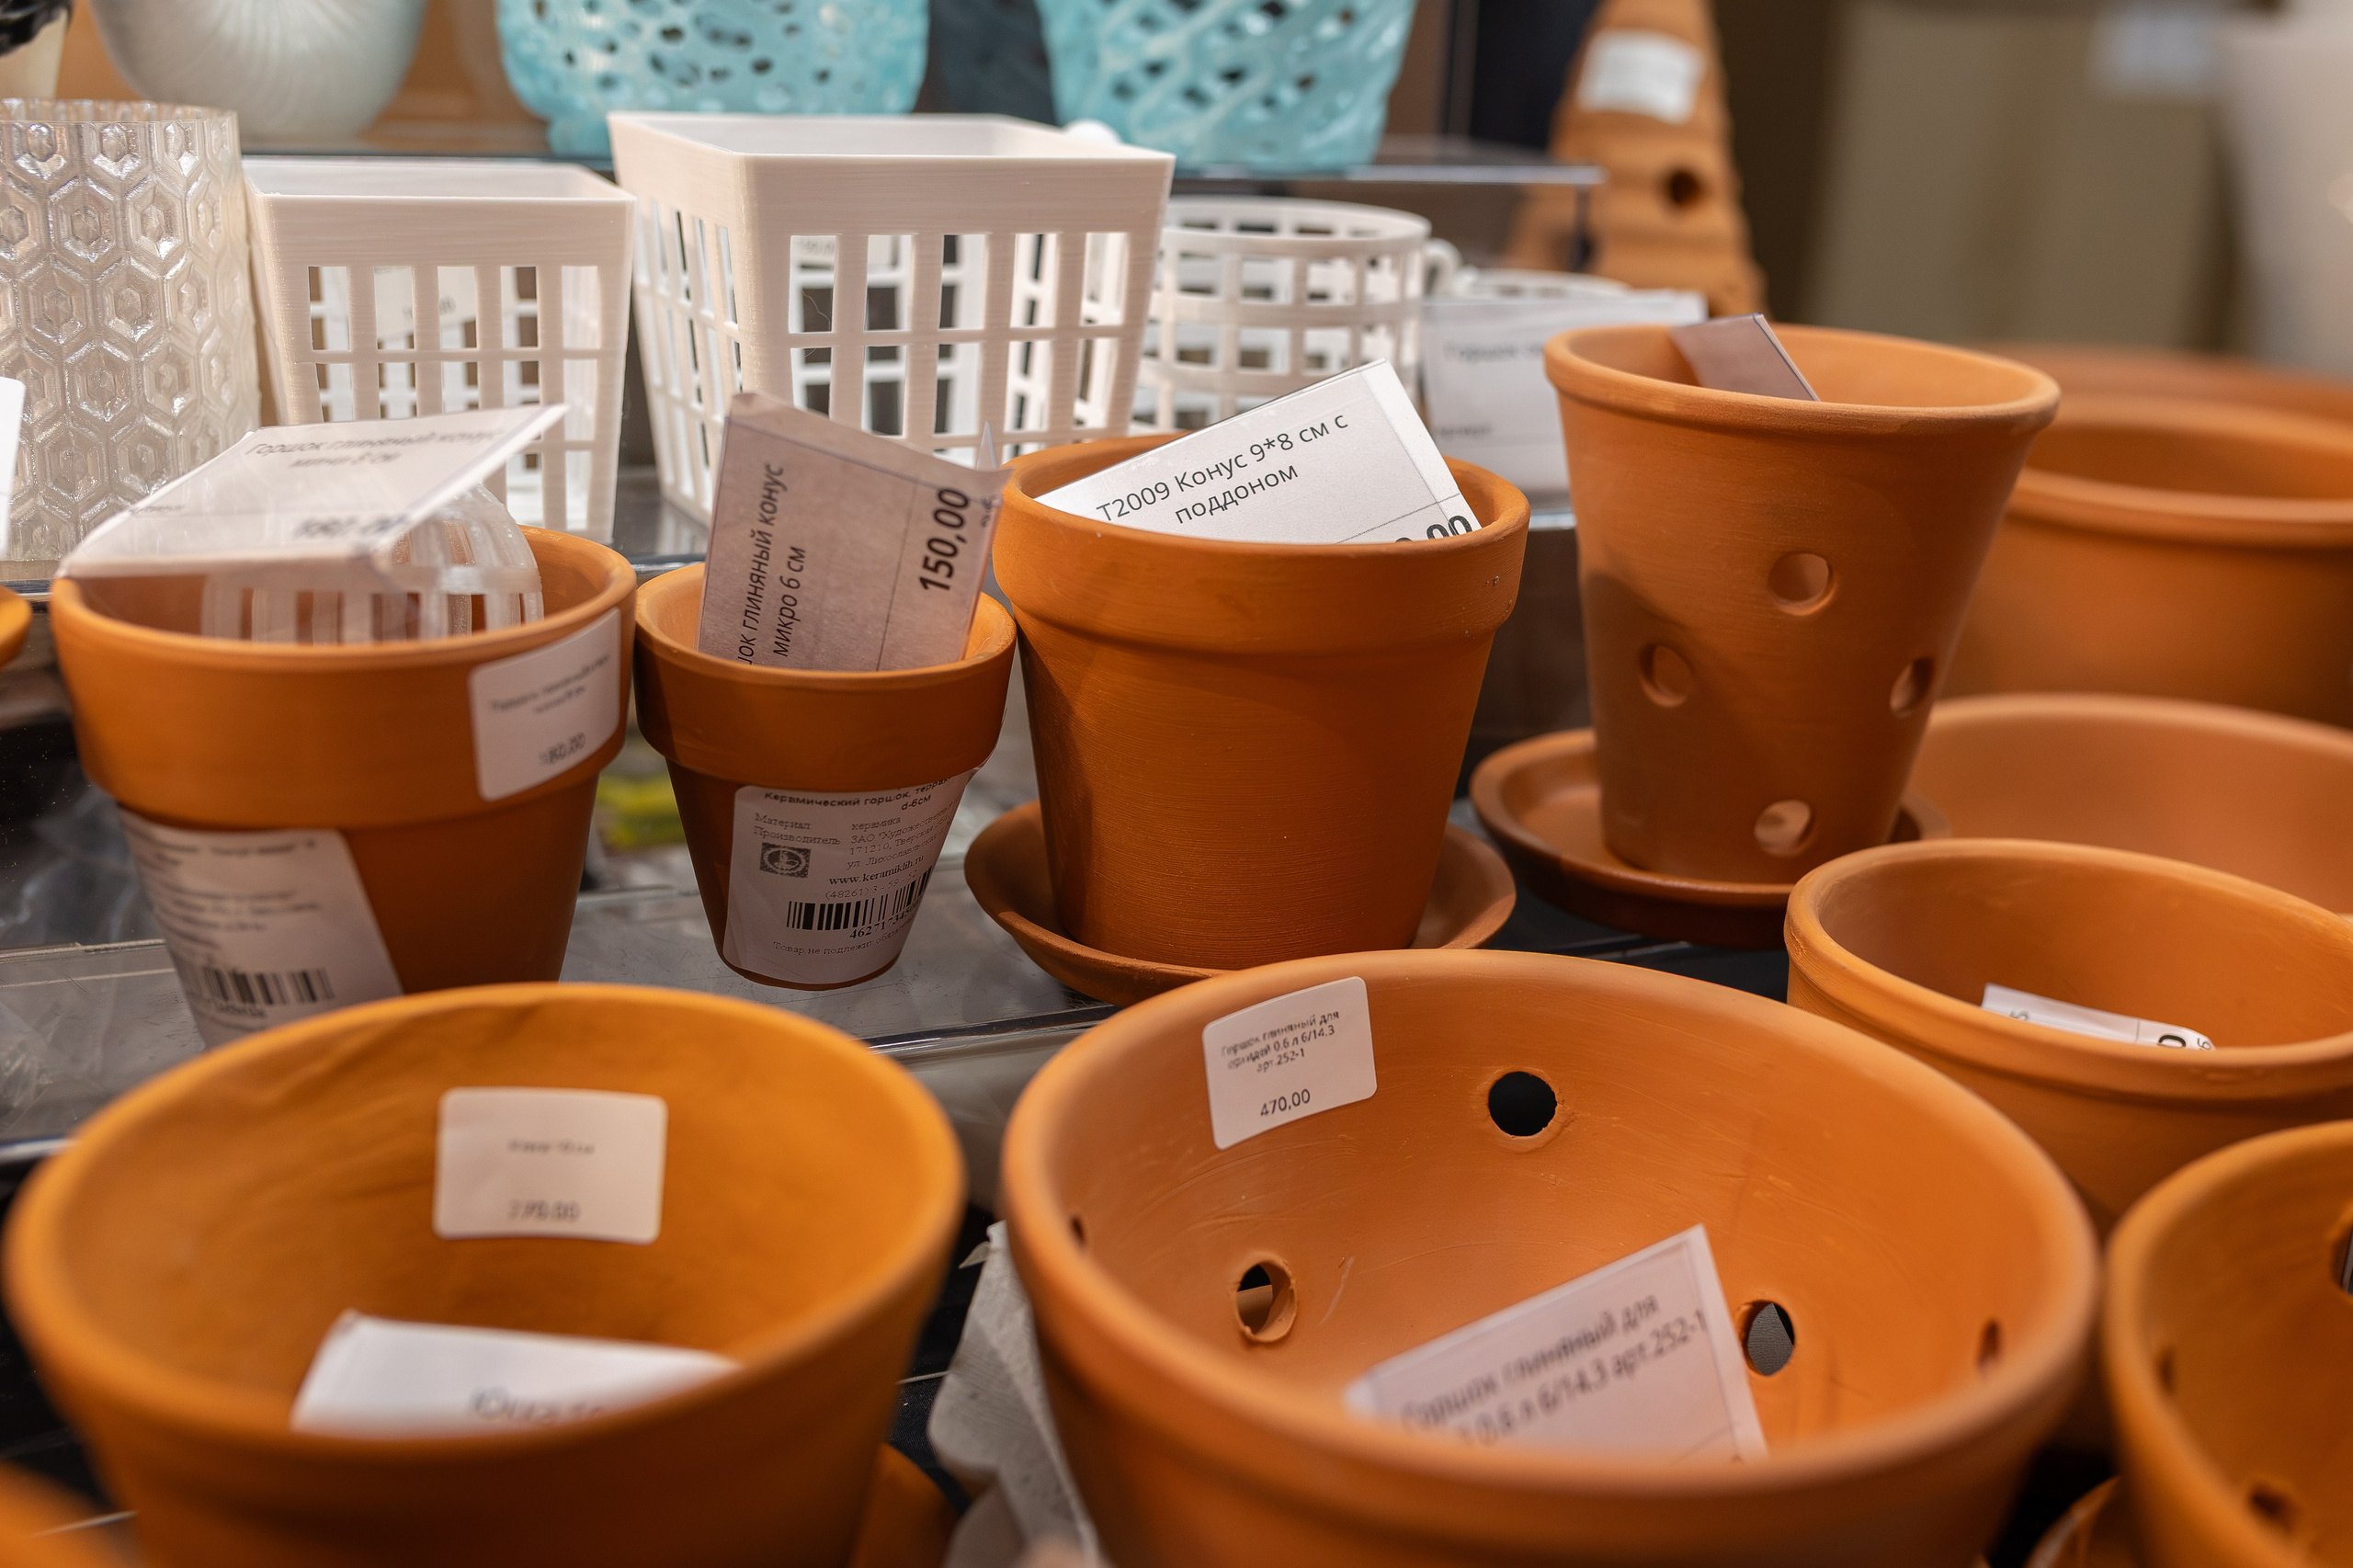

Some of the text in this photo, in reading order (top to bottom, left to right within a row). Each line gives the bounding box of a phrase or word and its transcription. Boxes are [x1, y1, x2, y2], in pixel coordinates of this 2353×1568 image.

[1097, 480, 1172, 523] Т2009
[1174, 449, 1248, 494] Конус
[1299, 422, 1331, 444] см
[1335, 414, 1349, 430] с
[1175, 462, 1299, 526] поддоном
[744, 528, 773, 630] глиняный
[760, 463, 787, 530] конус
[919, 487, 970, 591] 150,00
[773, 545, 807, 657] микро 6 см
[850, 834, 876, 845] ЗАО
[1301, 1025, 1336, 1044] 6/14.3
[1319, 1011, 1340, 1026] для
[1260, 1088, 1311, 1117] 470,00
